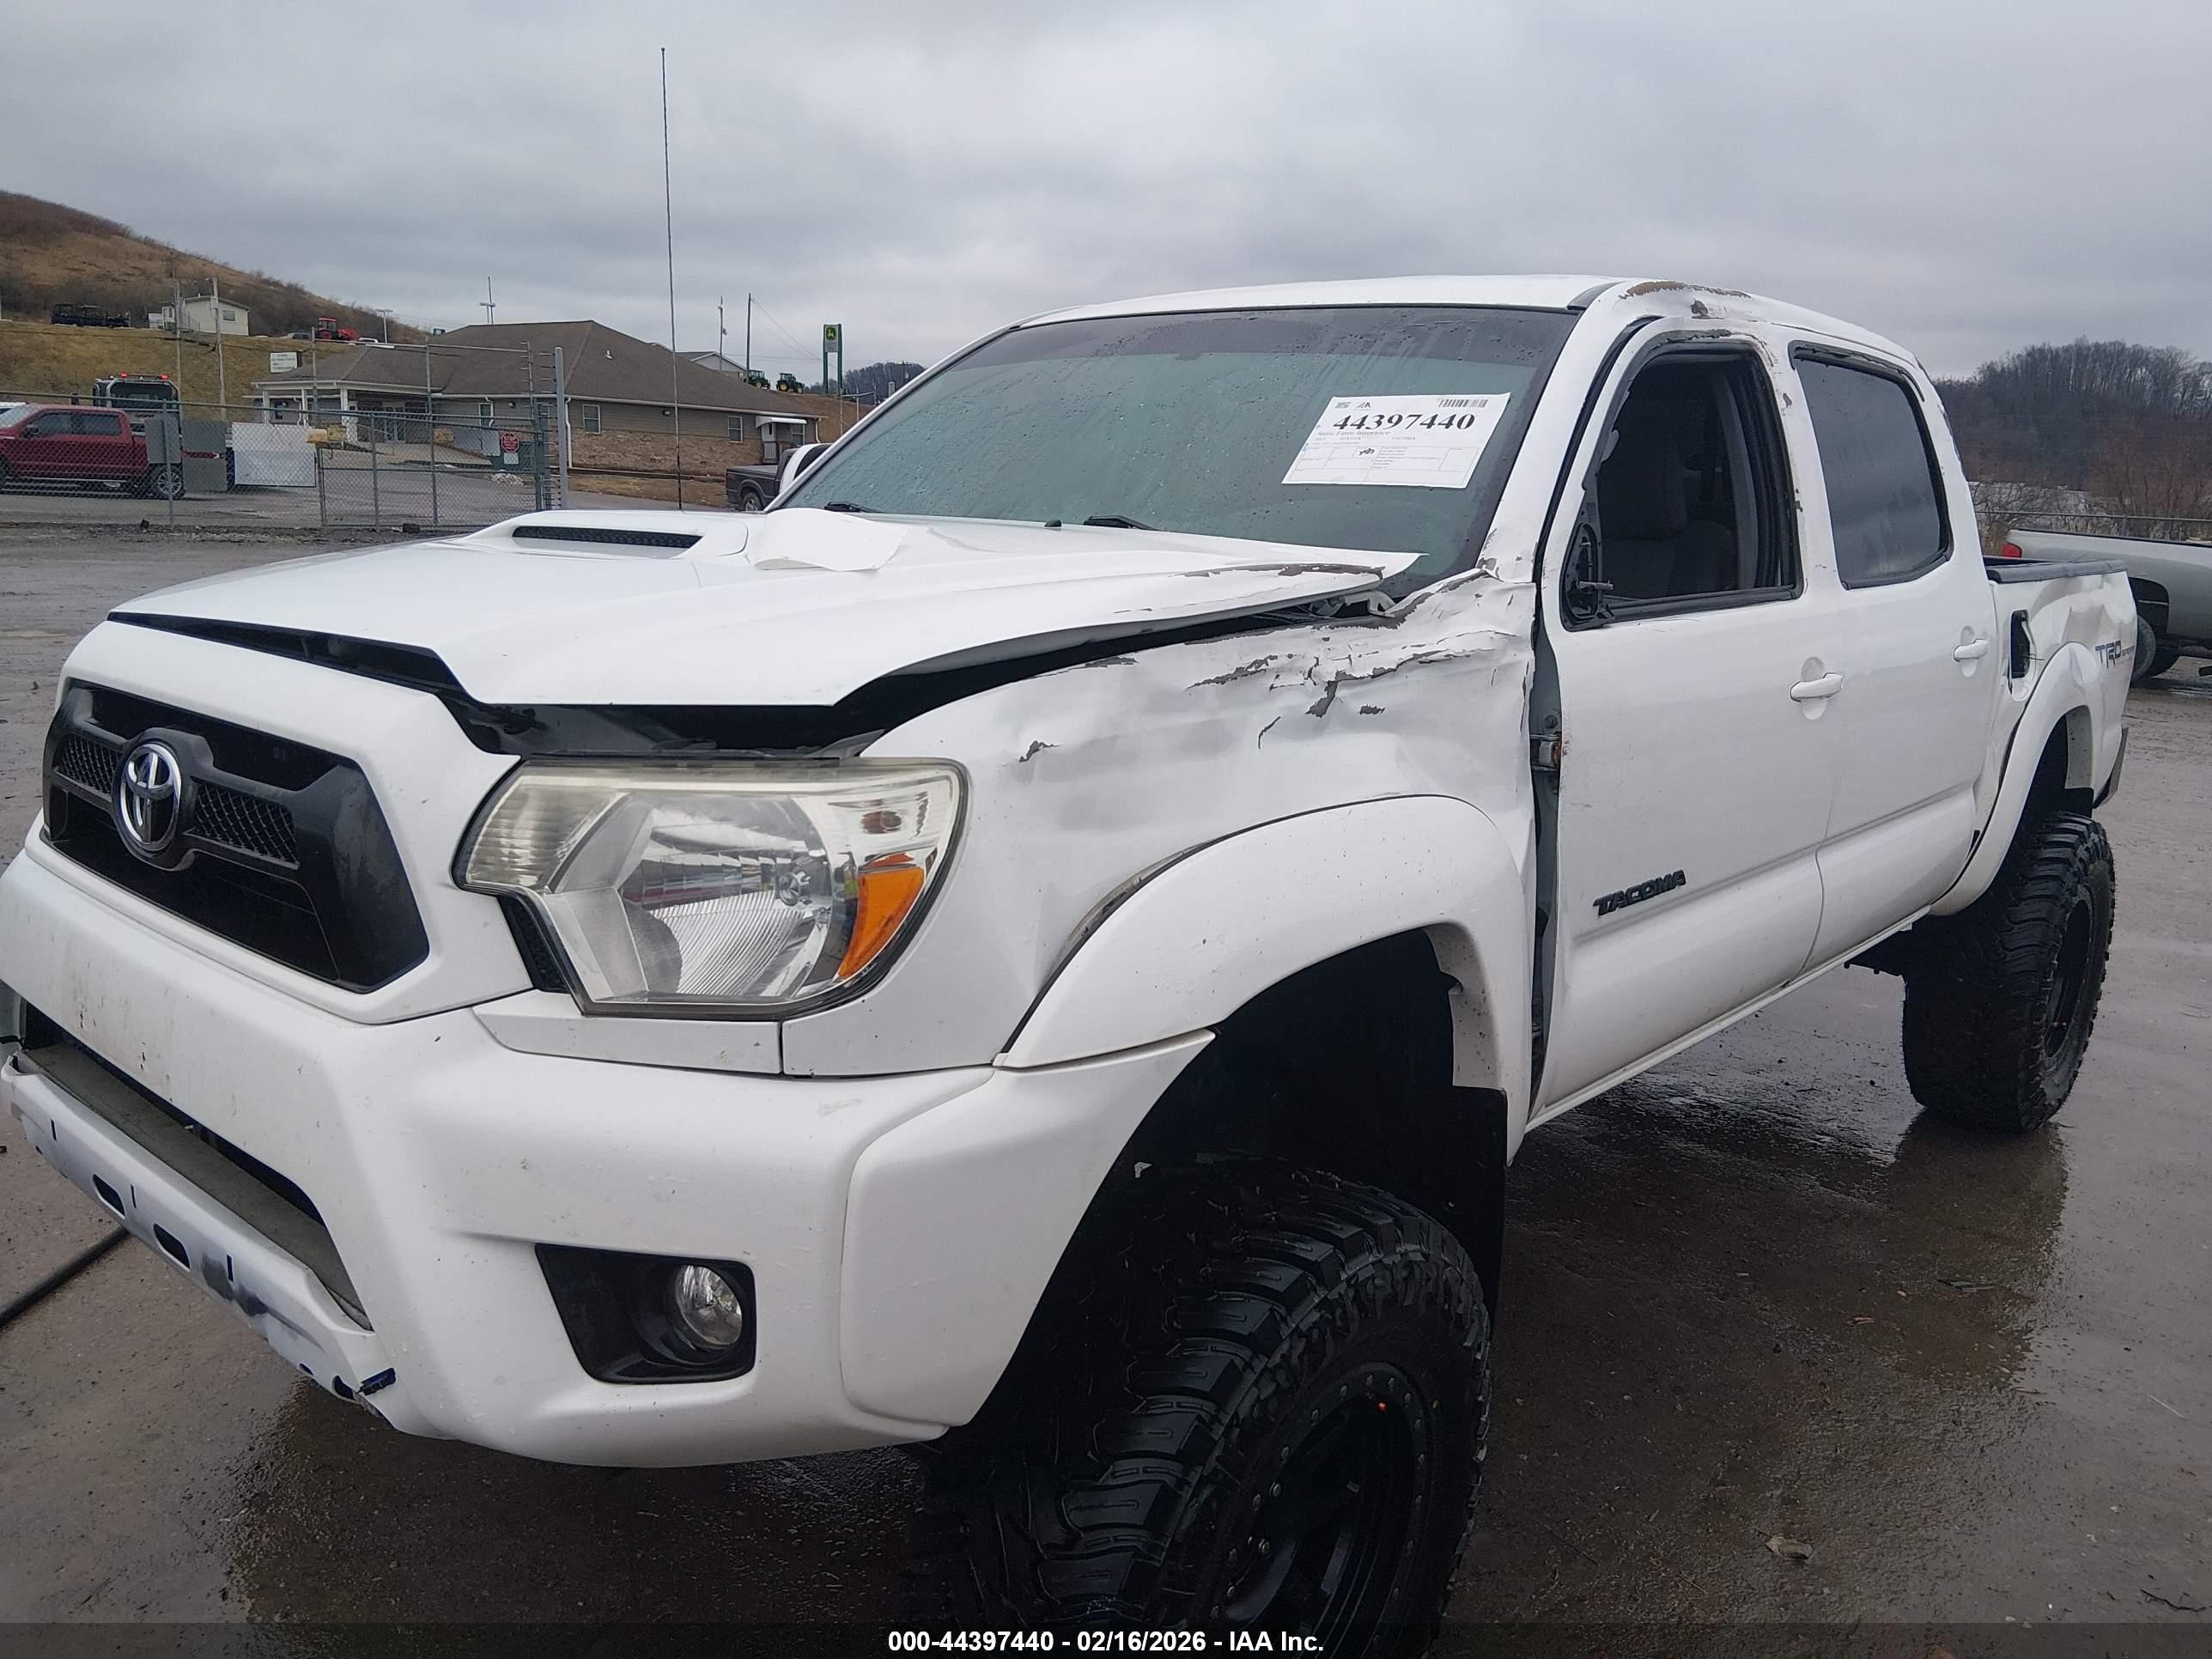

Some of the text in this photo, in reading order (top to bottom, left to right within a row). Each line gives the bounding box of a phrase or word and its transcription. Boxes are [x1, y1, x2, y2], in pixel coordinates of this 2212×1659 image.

[1333, 413, 1475, 430] 44397440
[2095, 640, 2121, 668] TRD
[1592, 869, 1686, 916] TACOMA
